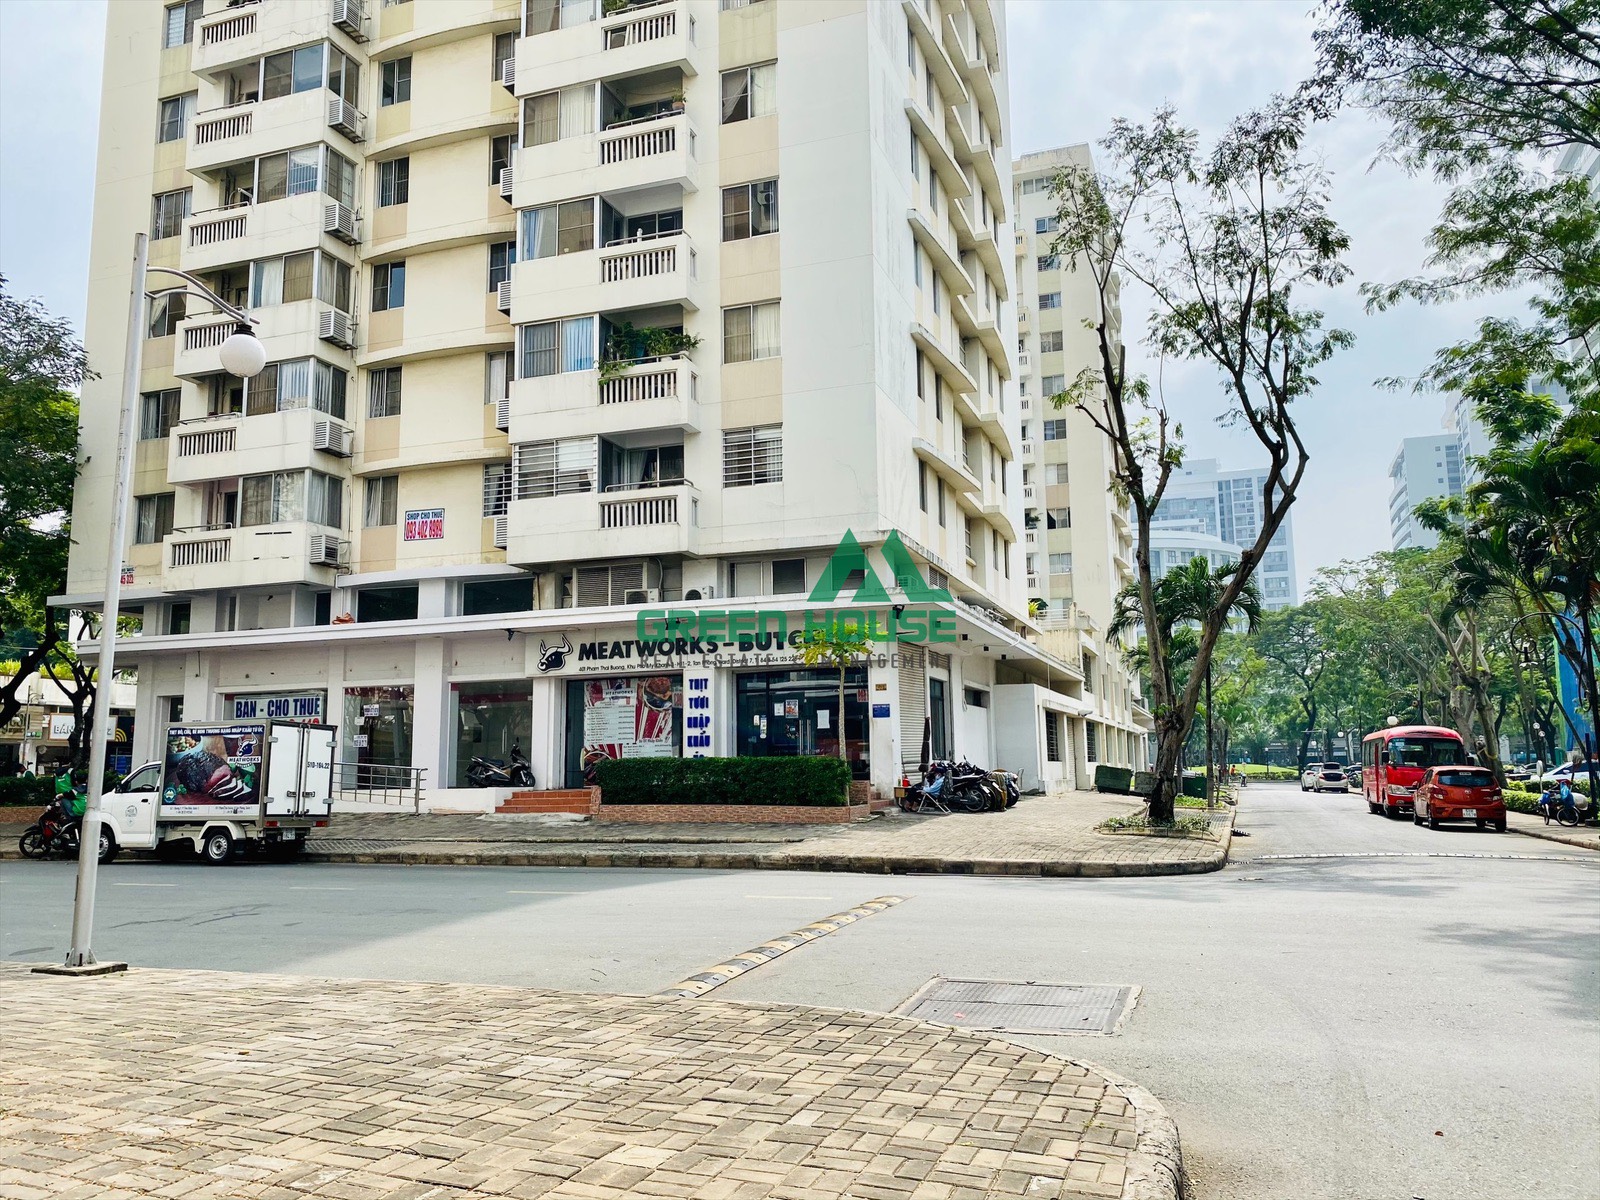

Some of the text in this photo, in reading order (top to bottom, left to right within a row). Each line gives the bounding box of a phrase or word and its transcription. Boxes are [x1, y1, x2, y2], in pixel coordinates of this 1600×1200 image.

[406, 521, 417, 539] 093
[417, 520, 428, 538] 402
[578, 635, 719, 661] MEATWORKS
[688, 678, 709, 692] THỊT
[236, 698, 256, 718] BÁN
[267, 699, 289, 717] CHO
[293, 694, 320, 716] THUÊ
